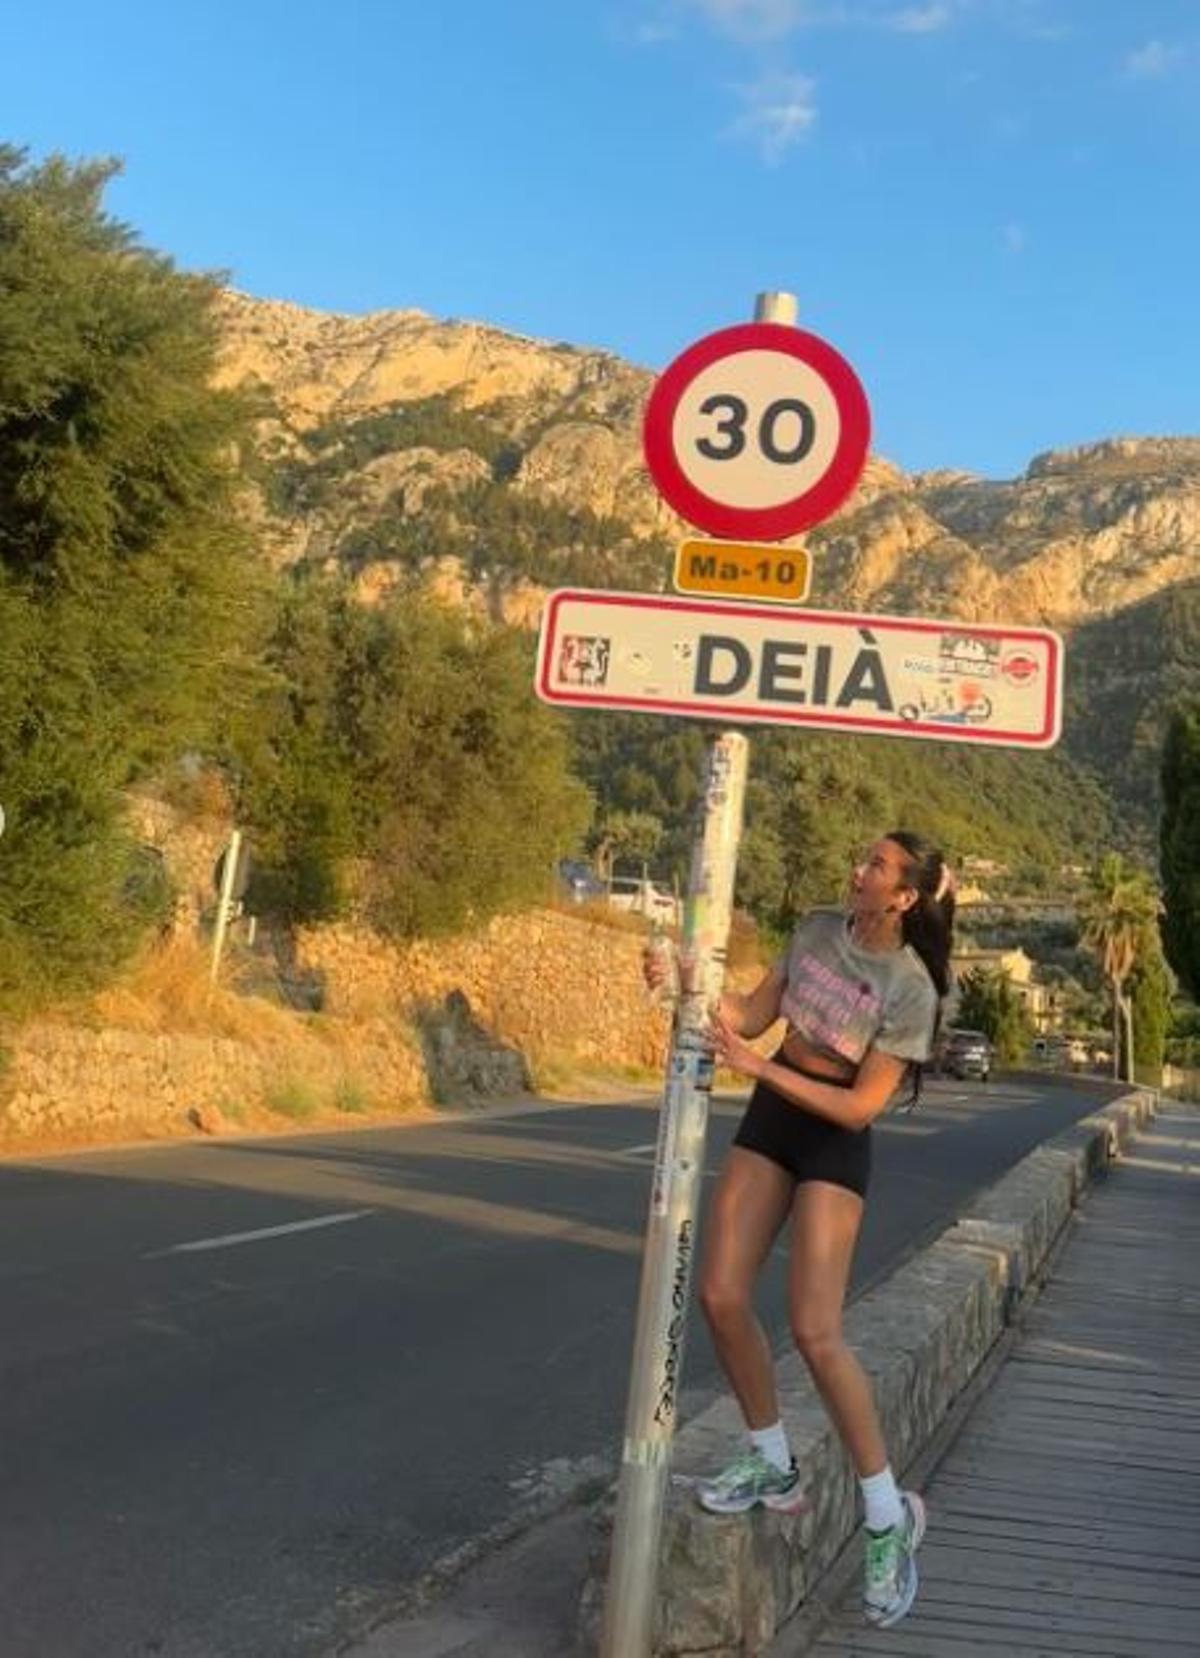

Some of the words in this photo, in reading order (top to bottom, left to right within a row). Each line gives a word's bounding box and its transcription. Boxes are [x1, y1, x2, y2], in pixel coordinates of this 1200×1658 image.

[695, 395, 815, 464] 30
[690, 556, 796, 584] Ma-10
[693, 630, 894, 711] DEIÀ
